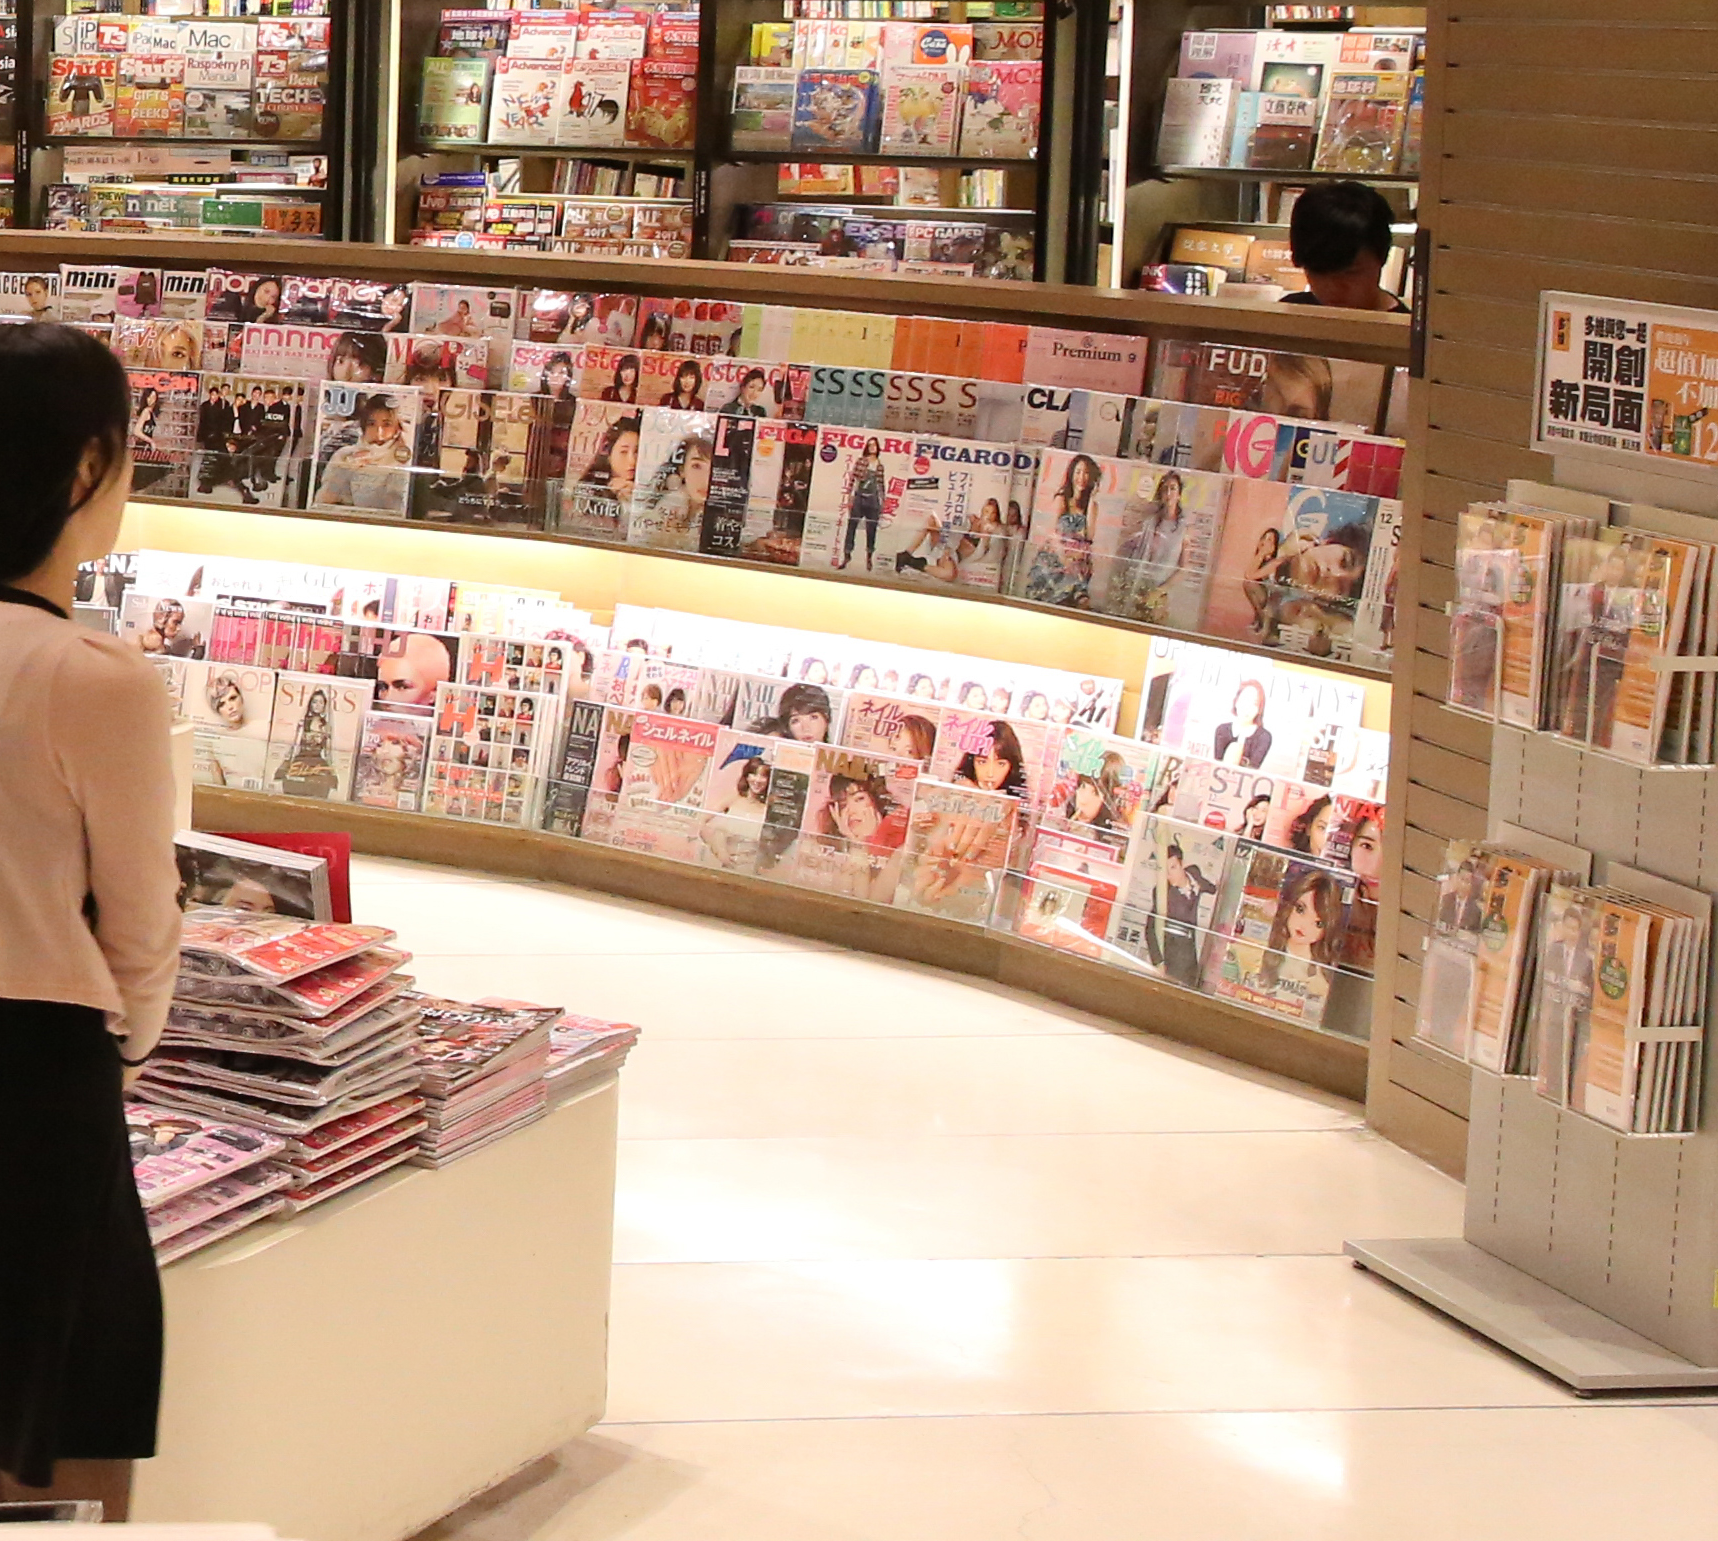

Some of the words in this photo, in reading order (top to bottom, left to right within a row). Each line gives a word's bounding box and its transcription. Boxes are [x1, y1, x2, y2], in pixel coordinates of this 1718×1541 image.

[189, 29, 231, 48] Mac
[521, 26, 573, 37] Advanced
[509, 61, 562, 72] Advanced
[133, 89, 169, 101] GIFTS
[131, 107, 169, 120] GEEKS
[146, 197, 176, 212] net
[65, 270, 117, 289] mini
[1052, 341, 1122, 364] Premium
[1582, 339, 1648, 388] 開創
[322, 388, 359, 417] JJ
[1548, 378, 1646, 434] 新局面
[915, 441, 1014, 468] FIGARO
[860, 698, 905, 723] ネイル
[872, 717, 905, 739] UP!
